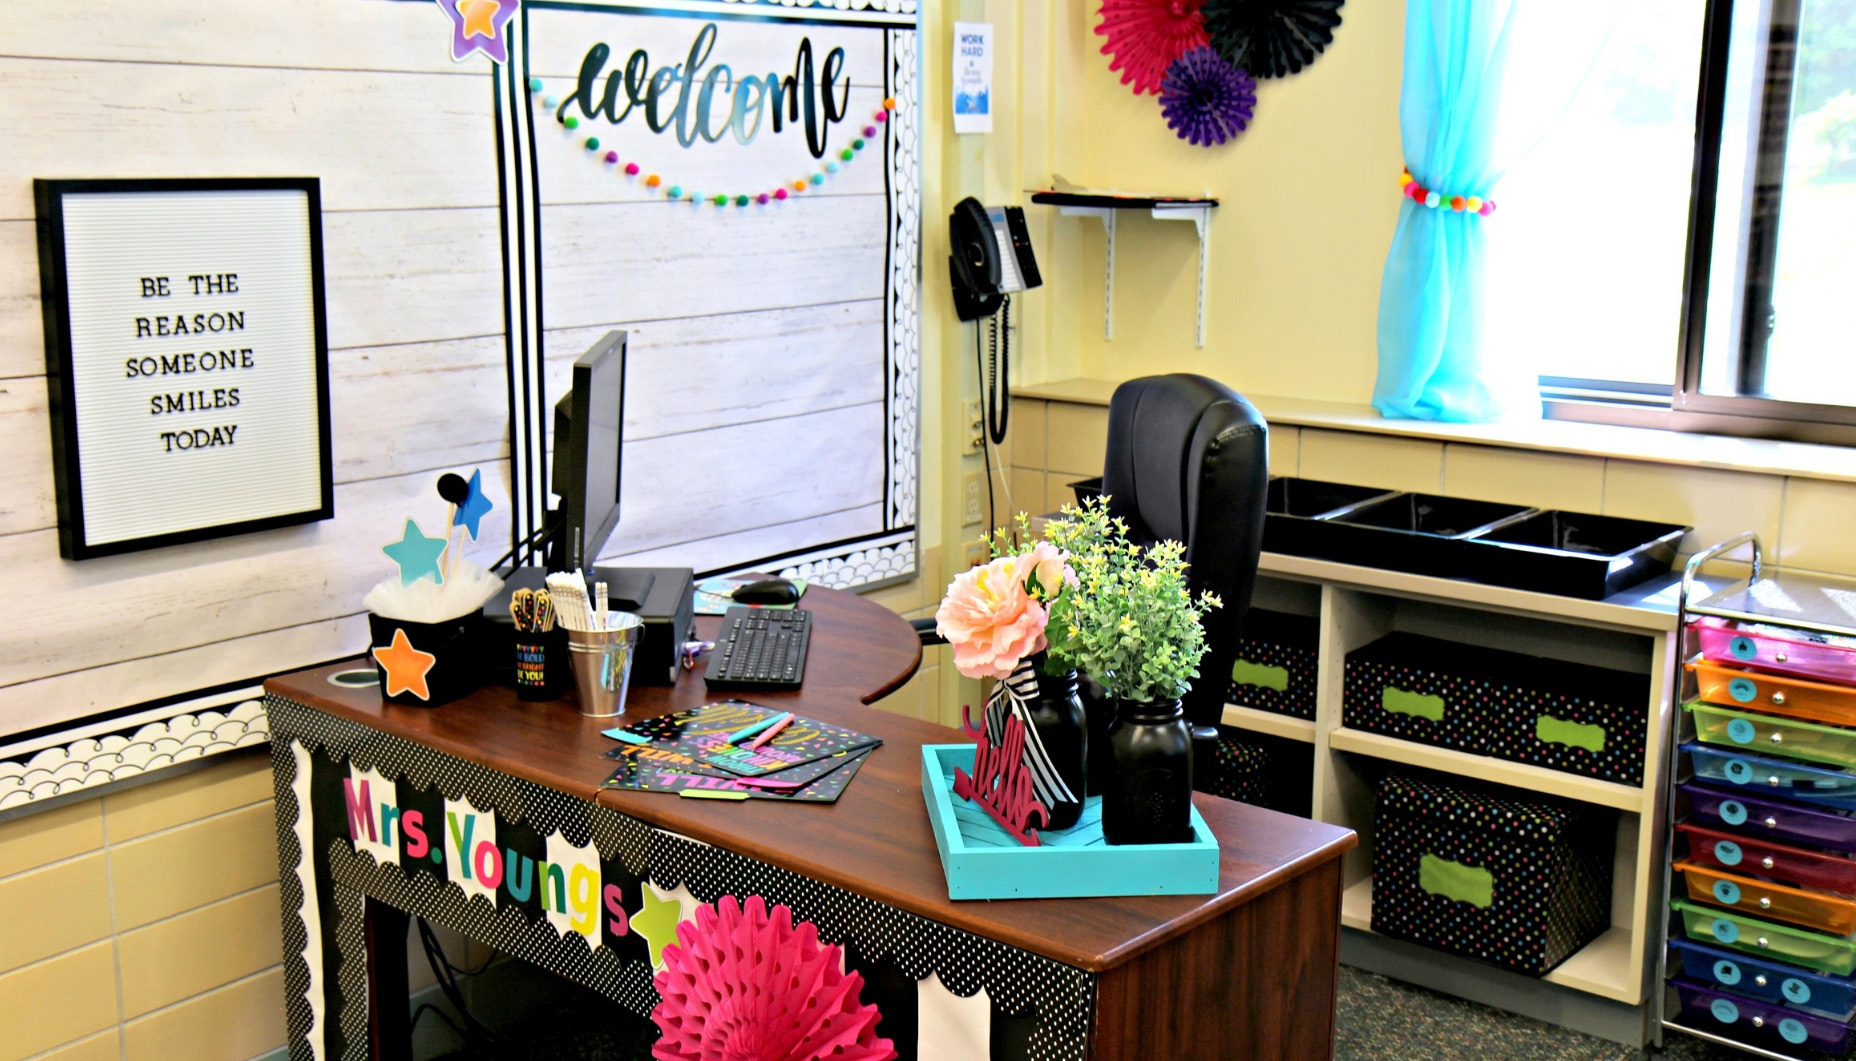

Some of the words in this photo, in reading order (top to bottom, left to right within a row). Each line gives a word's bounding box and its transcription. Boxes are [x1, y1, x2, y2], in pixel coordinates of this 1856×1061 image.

[961, 34, 984, 45] WORK
[961, 46, 983, 57] HARD
[557, 22, 850, 159] welcome
[140, 277, 171, 297] BE
[188, 273, 239, 295] THE
[135, 311, 245, 337] REASON
[126, 348, 254, 378] SOMEONE
[151, 388, 240, 415] SMILES
[161, 425, 238, 451] TODAY
[621, 745, 695, 765] WILL
[343, 778, 443, 864] Mrs.
[447, 811, 629, 938] Youngs
